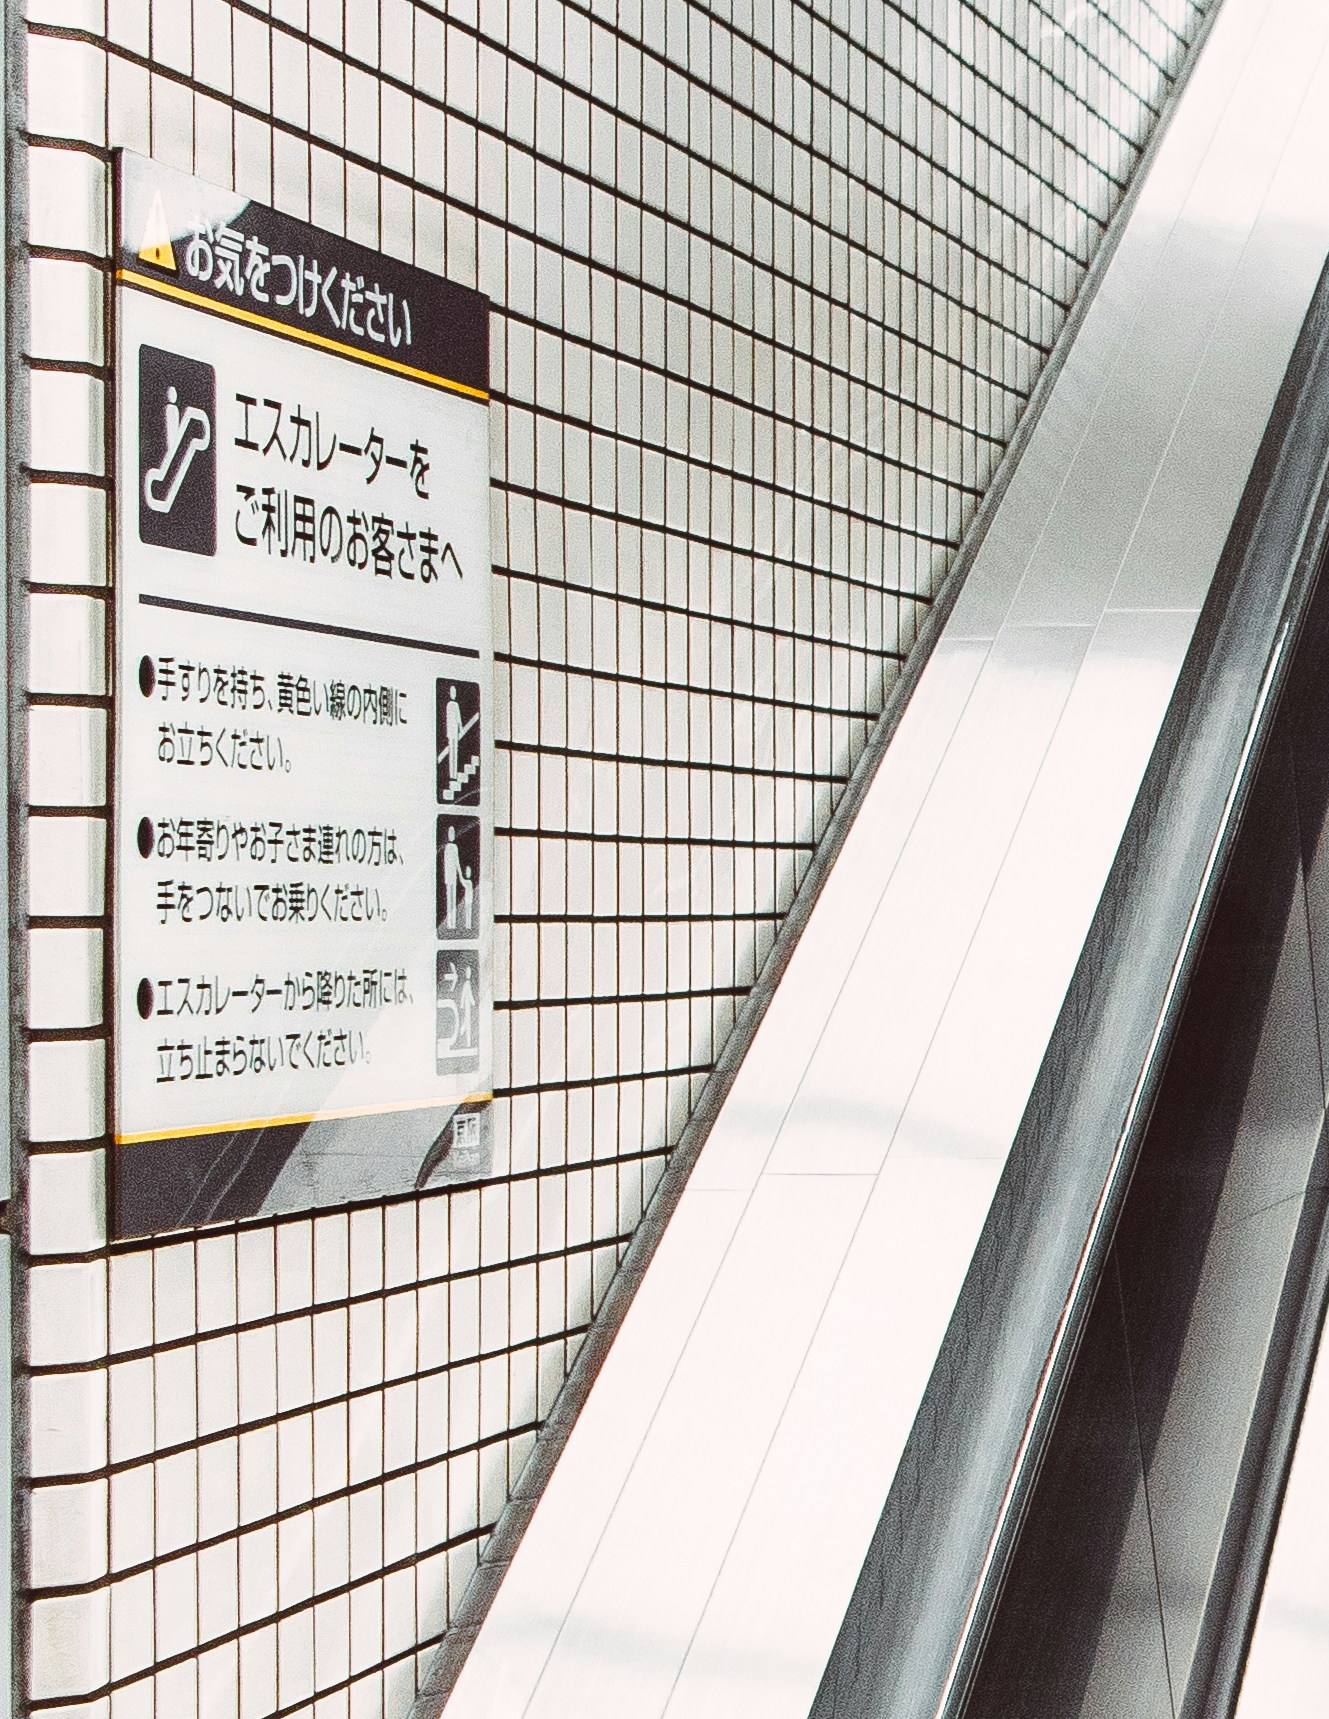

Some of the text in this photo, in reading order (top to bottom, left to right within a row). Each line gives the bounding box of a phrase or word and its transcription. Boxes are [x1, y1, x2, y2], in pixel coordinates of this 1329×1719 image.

[185, 216, 412, 347] お気をつけください
[234, 393, 430, 499] エスカレーターを
[234, 484, 464, 583] ご利用のお客さまへ
